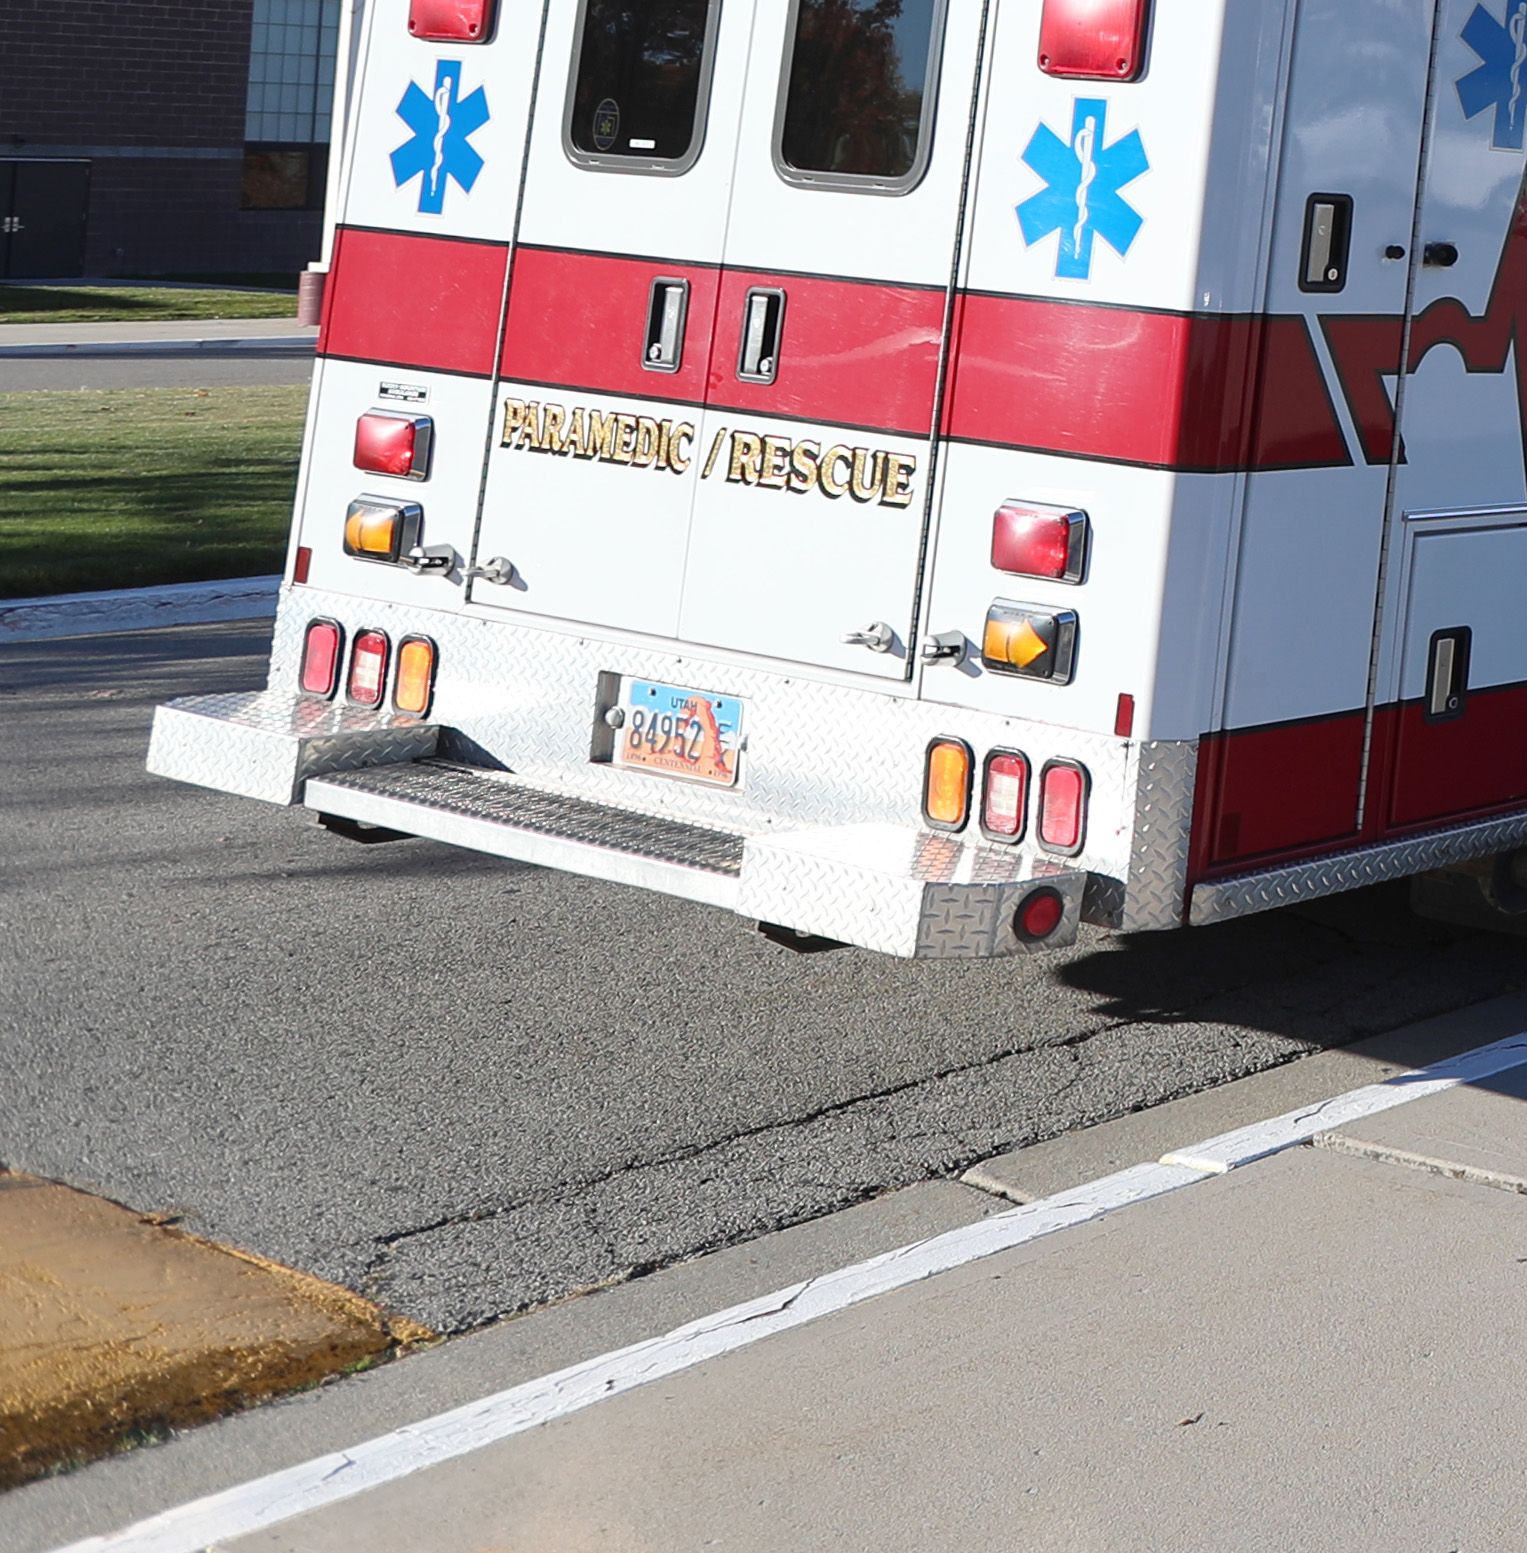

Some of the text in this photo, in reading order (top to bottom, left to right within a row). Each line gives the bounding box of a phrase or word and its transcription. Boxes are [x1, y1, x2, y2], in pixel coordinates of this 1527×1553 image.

[499, 397, 696, 474] PARAMEDIC
[725, 429, 917, 509] RESCUE
[671, 696, 698, 711] UTAH
[630, 710, 703, 760] 84952
